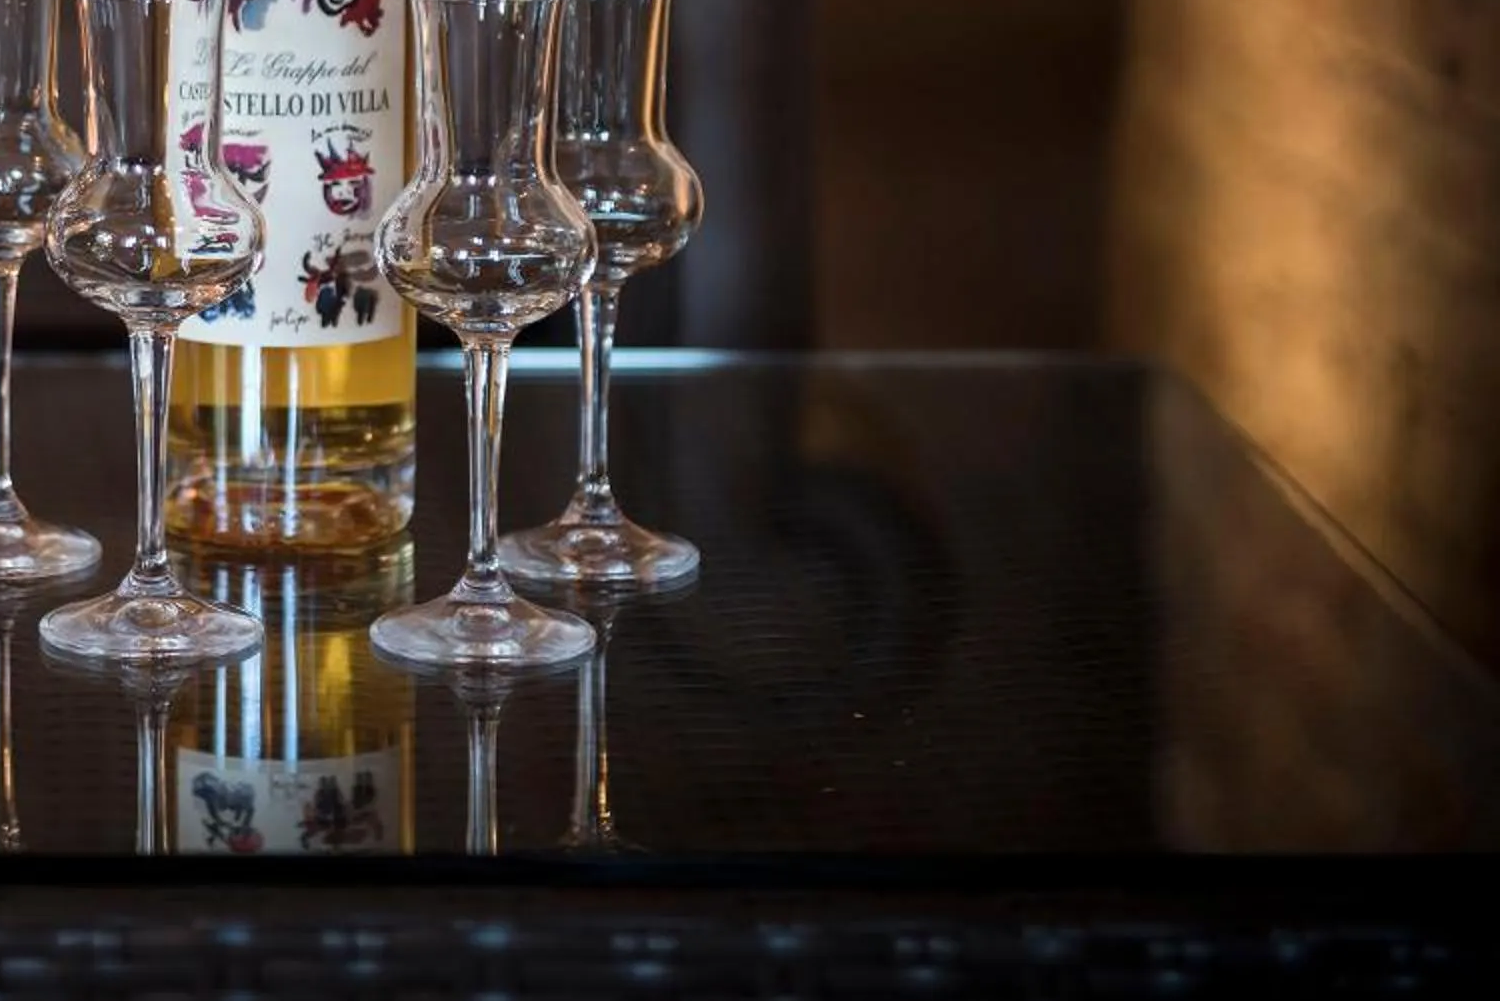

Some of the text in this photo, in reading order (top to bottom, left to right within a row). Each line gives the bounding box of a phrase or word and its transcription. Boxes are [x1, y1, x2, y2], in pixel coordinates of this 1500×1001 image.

[261, 50, 339, 86] Grappe
[222, 92, 303, 118] STELLO
[310, 92, 332, 117] DI
[337, 88, 391, 113] VILLA
